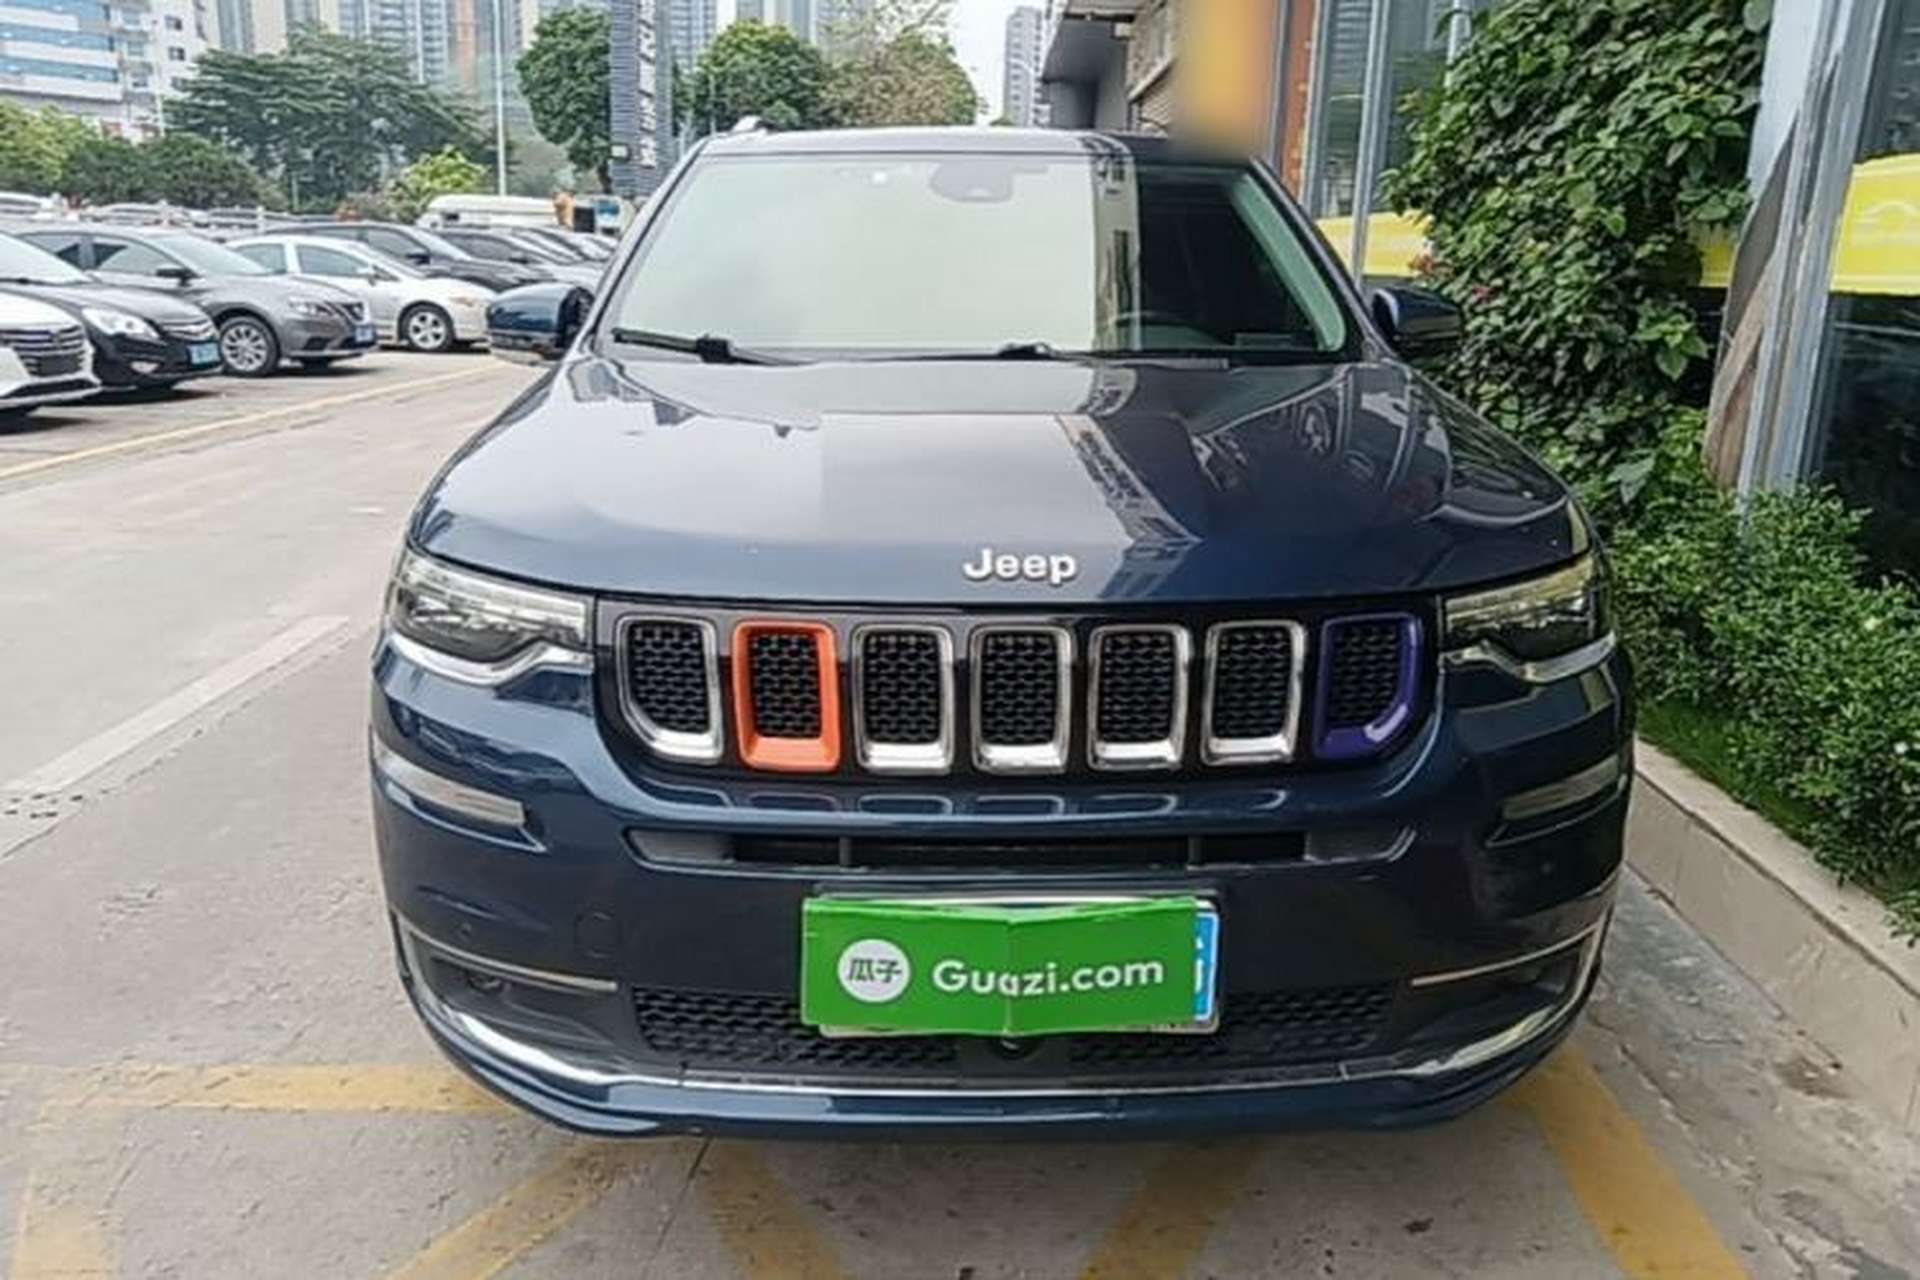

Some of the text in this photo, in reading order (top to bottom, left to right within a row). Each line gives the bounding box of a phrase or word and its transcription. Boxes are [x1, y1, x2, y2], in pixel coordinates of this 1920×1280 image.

[963, 548, 1077, 585] Jeep
[847, 957, 902, 984] 瓜子
[932, 959, 1164, 997] Guazi.com
